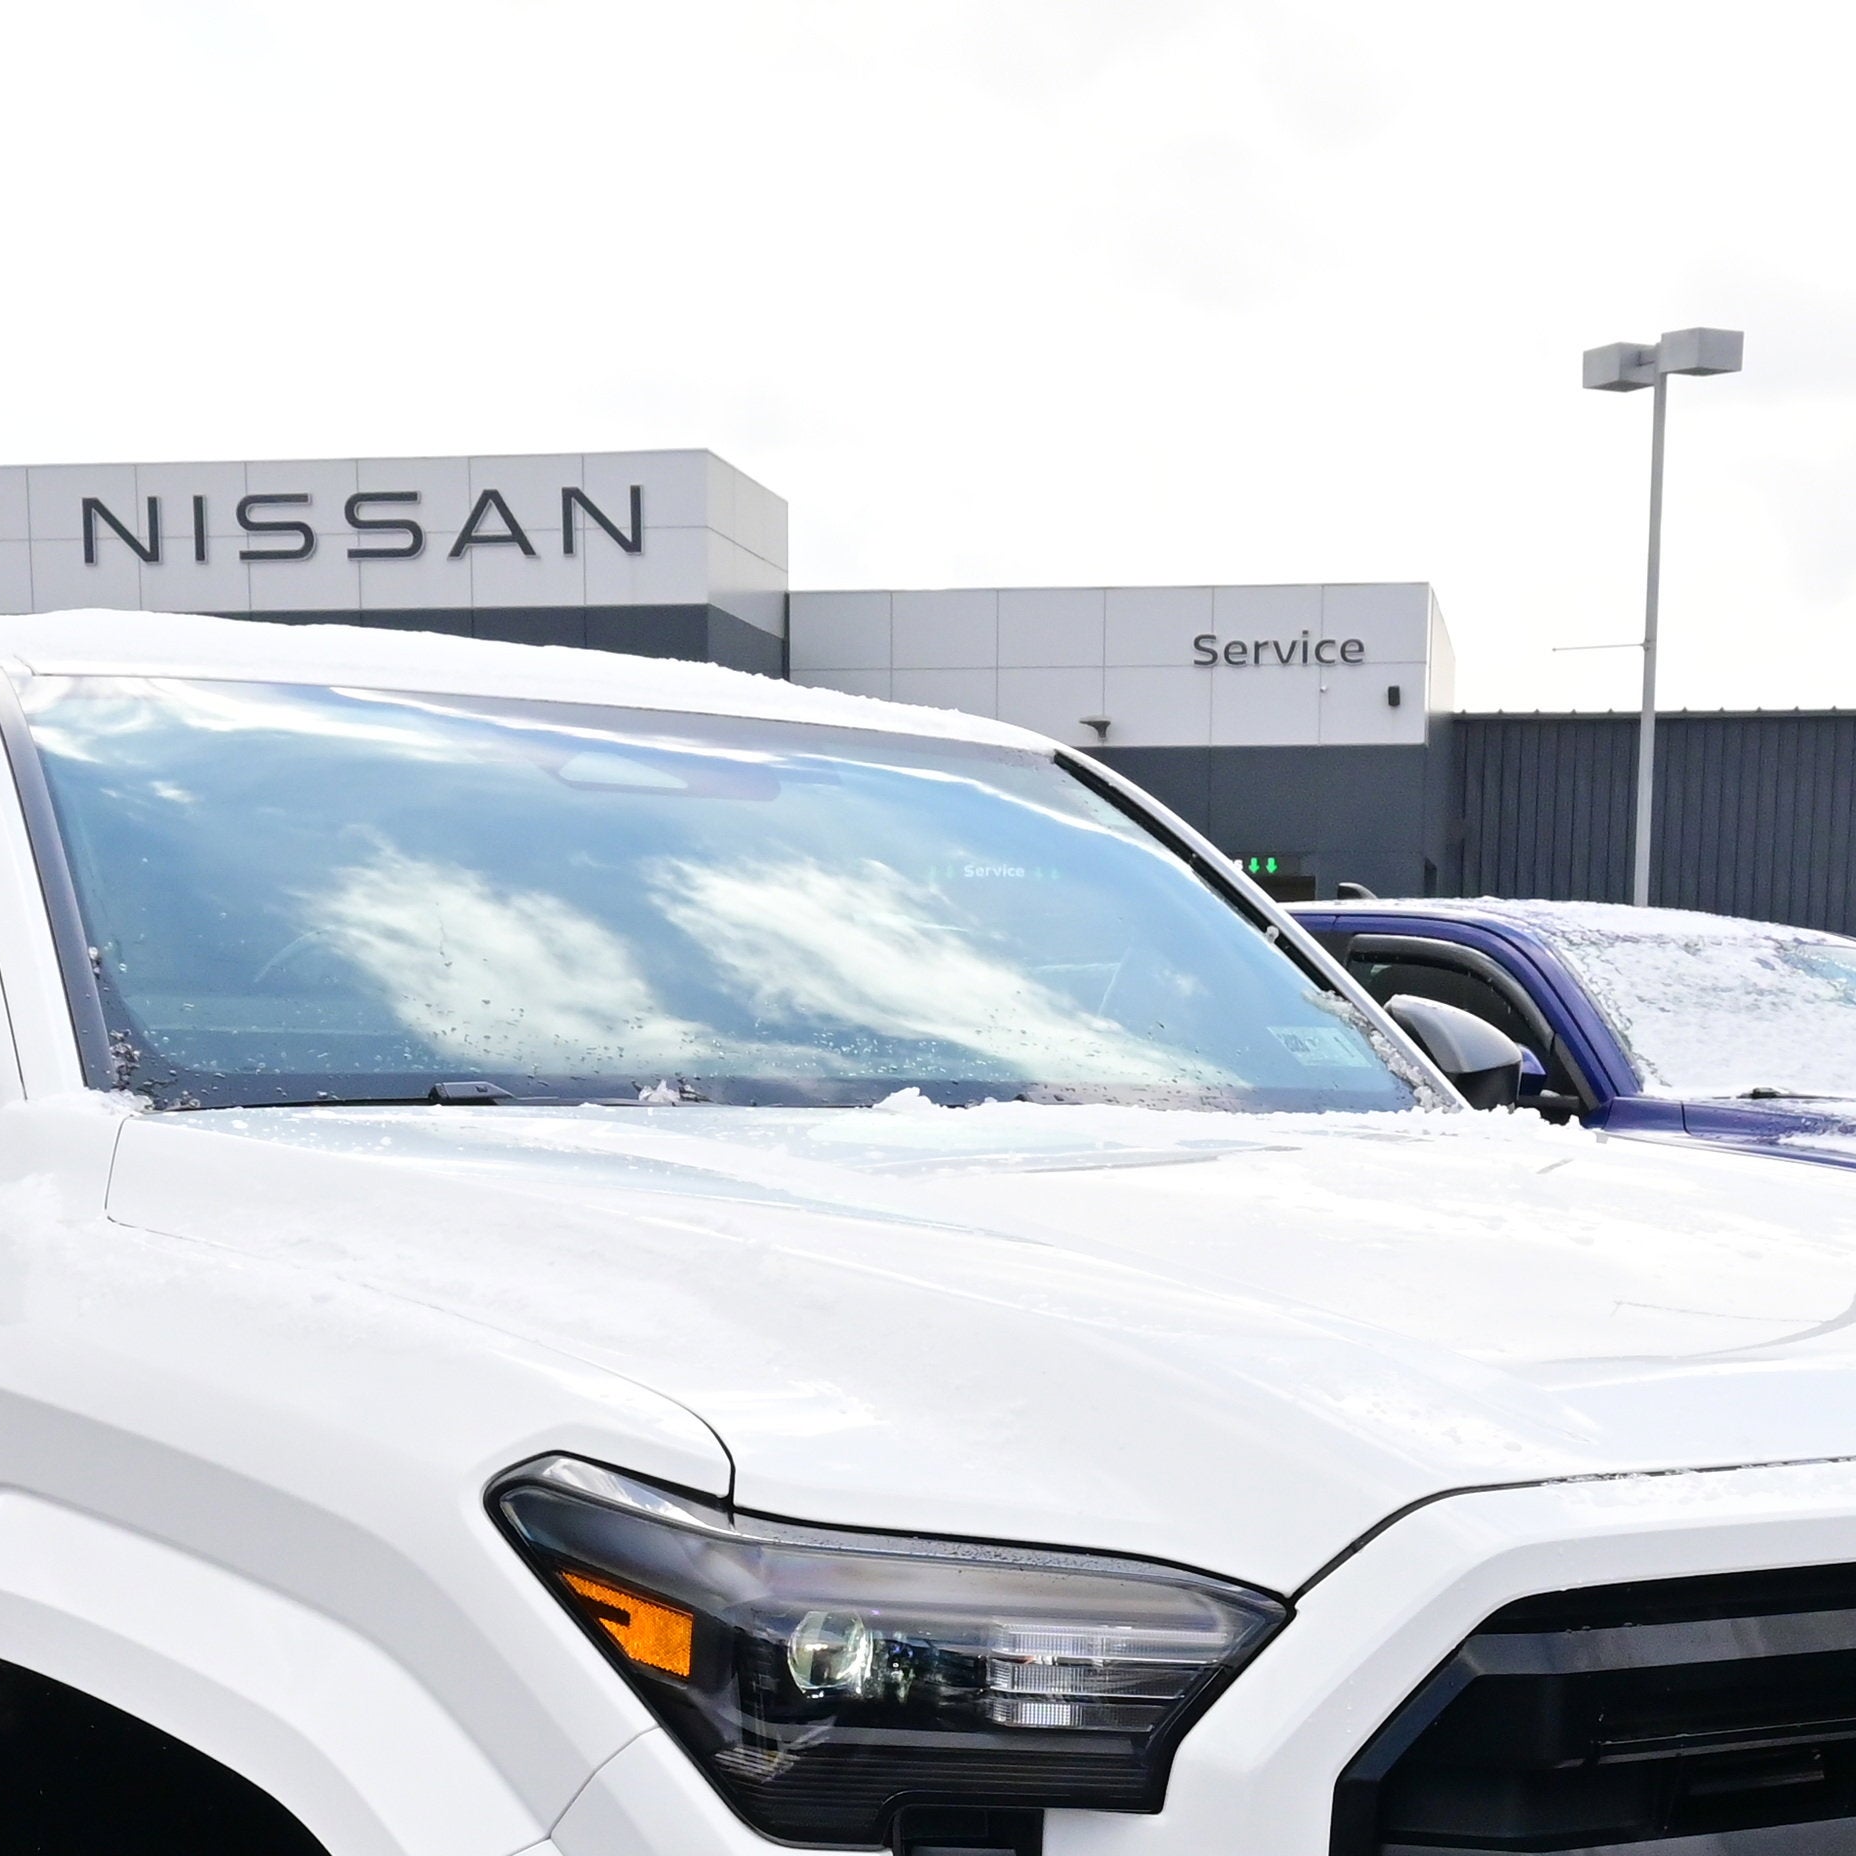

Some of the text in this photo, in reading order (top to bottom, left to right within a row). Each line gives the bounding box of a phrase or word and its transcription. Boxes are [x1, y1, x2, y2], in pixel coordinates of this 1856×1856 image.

[81, 485, 644, 565] NISSAN
[1193, 629, 1365, 666] Service
[963, 864, 1025, 878] Service
